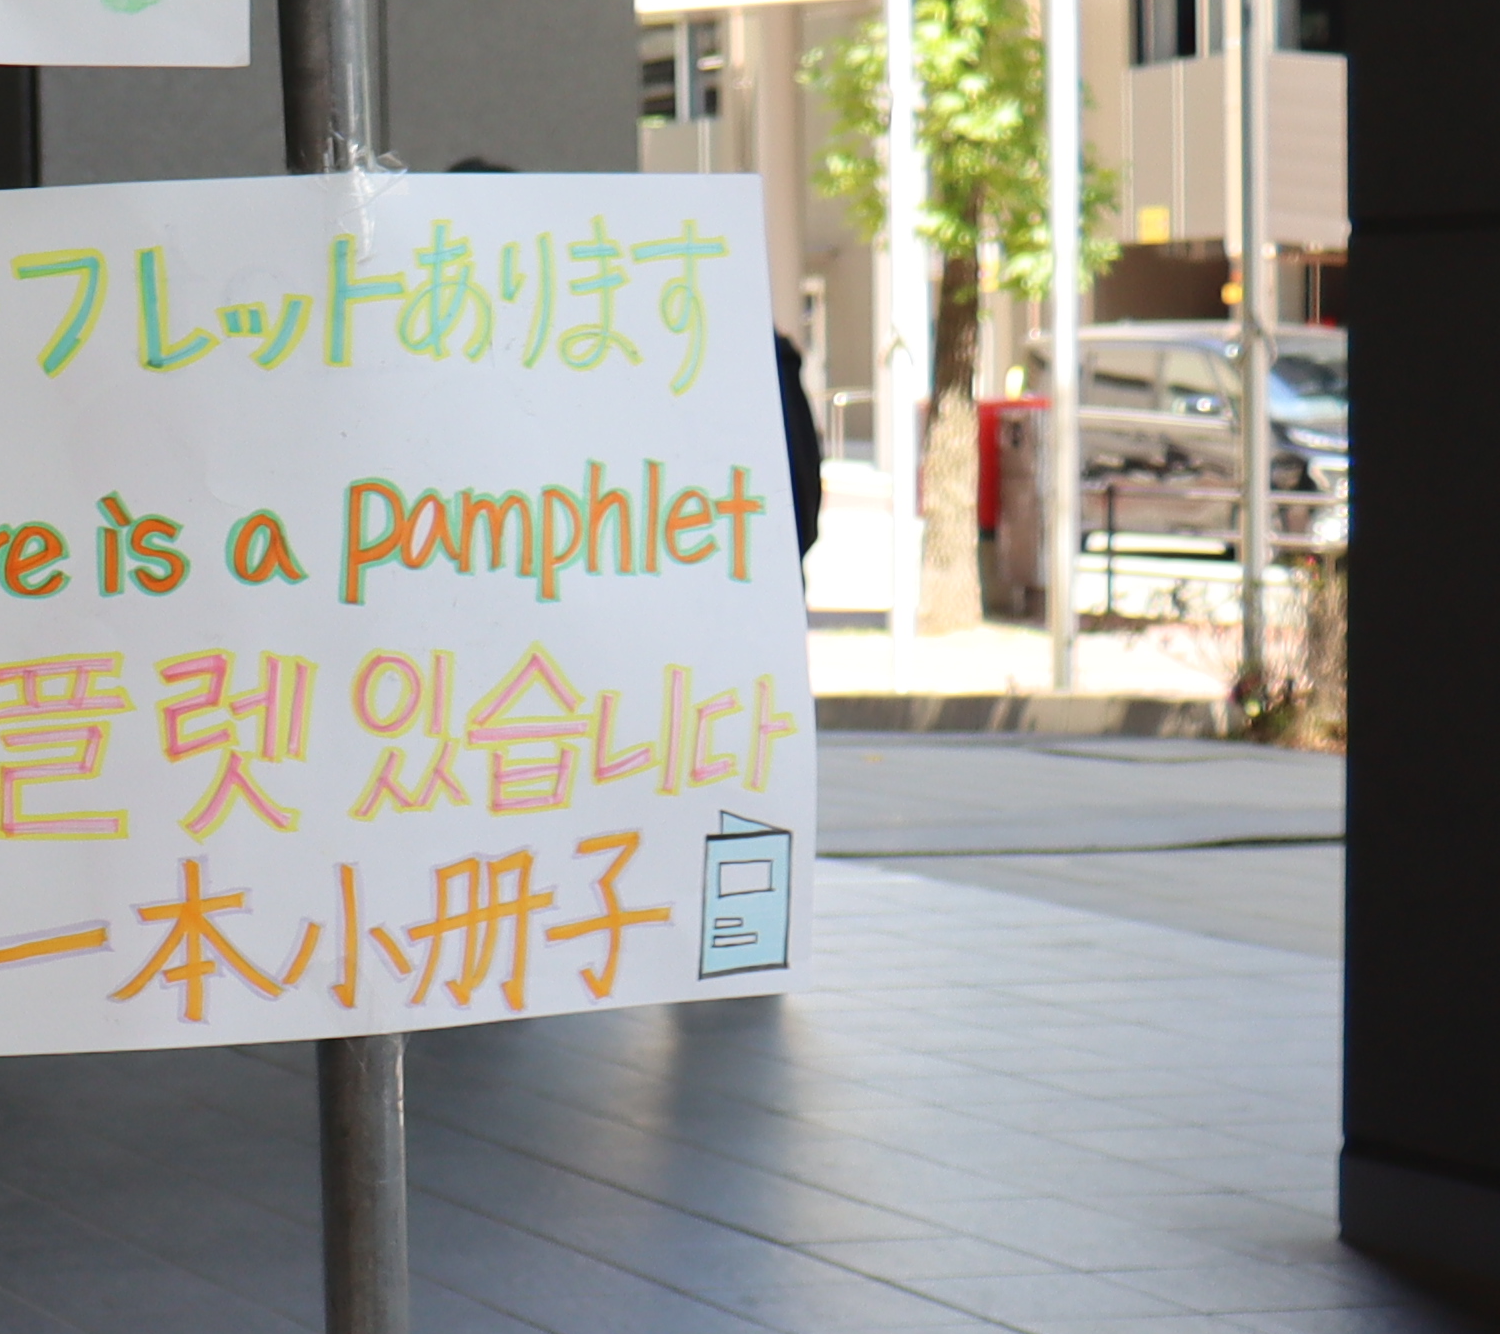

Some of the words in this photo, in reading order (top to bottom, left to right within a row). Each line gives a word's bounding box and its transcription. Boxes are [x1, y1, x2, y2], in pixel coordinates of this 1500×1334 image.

[96, 492, 190, 598] is
[225, 509, 307, 586] a
[344, 642, 797, 823] 있습니다
